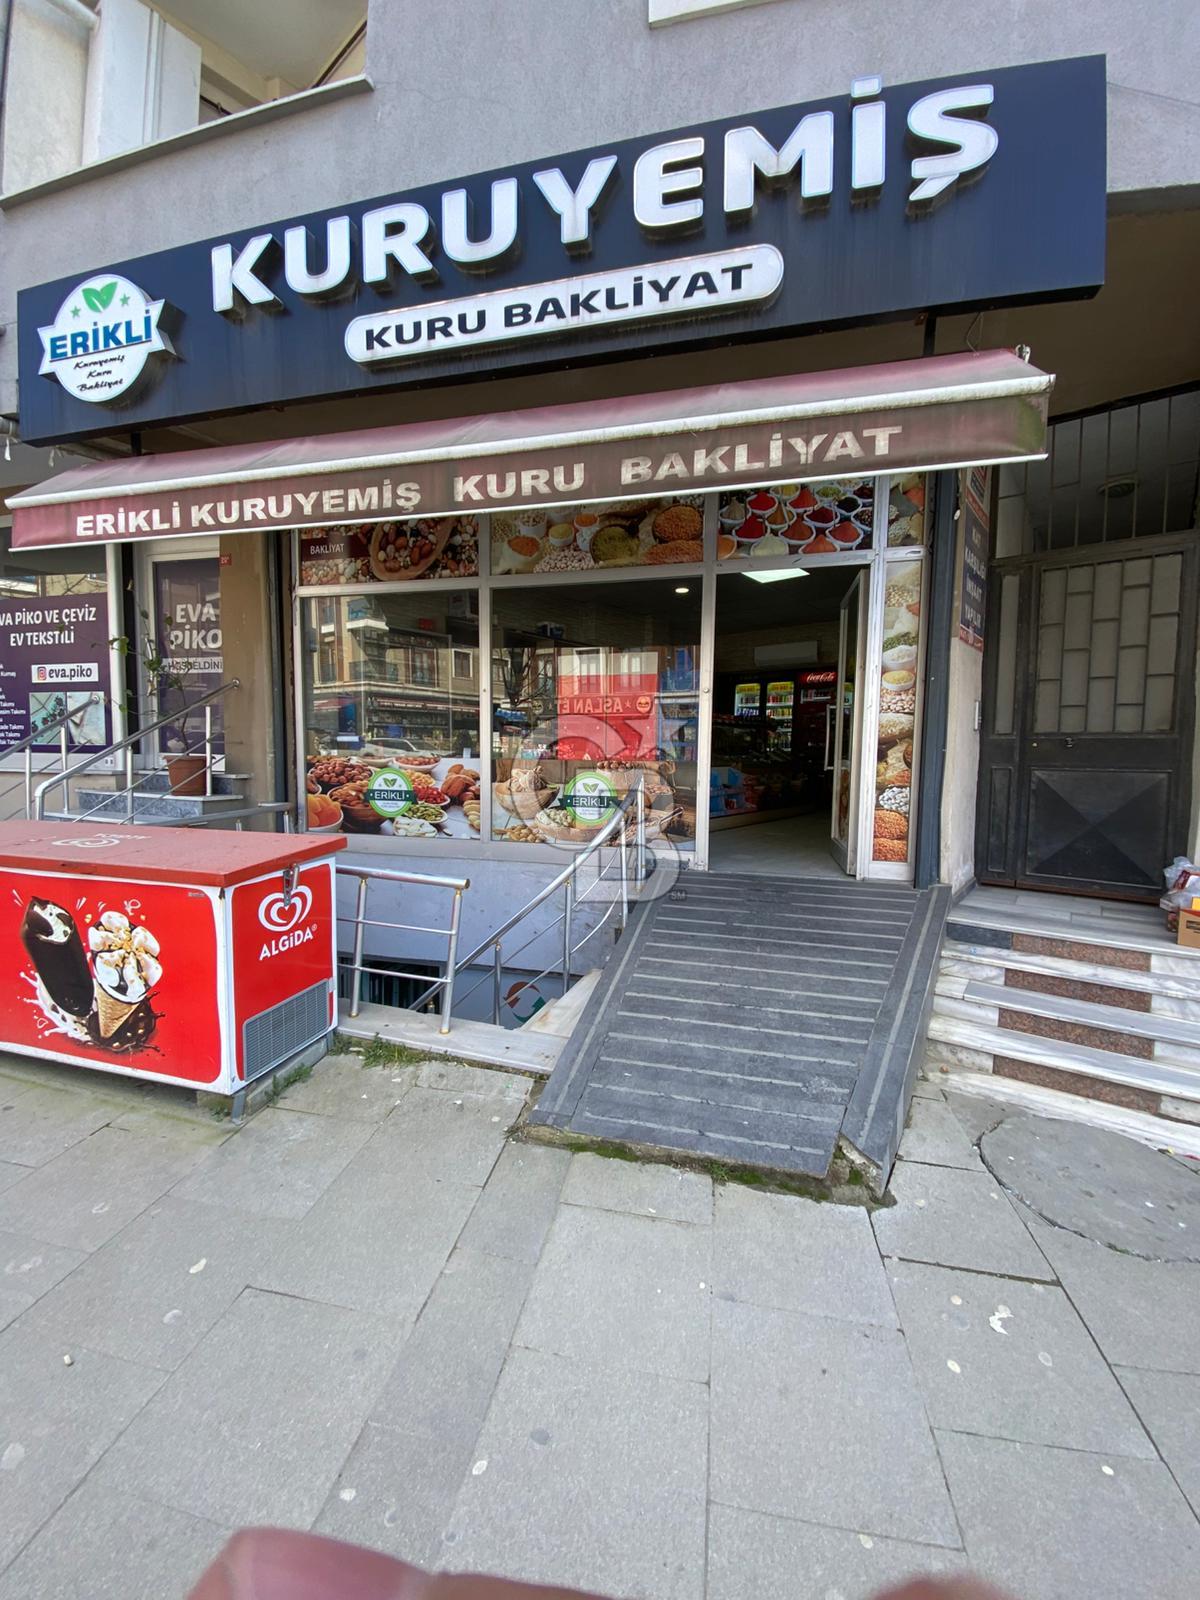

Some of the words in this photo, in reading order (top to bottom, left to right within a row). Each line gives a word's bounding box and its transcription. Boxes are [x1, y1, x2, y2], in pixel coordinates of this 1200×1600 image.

[211, 75, 998, 313] KURUYEMİŞ
[365, 309, 486, 350] KURU
[503, 263, 753, 327] BAKLİYAT
[50, 309, 152, 360] ERİKLİ
[76, 501, 181, 537] ERİKLİ
[191, 478, 422, 528] KURUYEMİŞ
[453, 462, 586, 502] KURU
[620, 425, 903, 486] BAKLİYAT
[0, 613, 13, 626] VA
[15, 608, 42, 625] PİKO
[45, 610, 59, 623] VE
[62, 604, 96, 625] ÇEYİZ
[176, 603, 216, 623] EVA
[10, 633, 24, 646] EV
[169, 625, 222, 650] PİKO
[48, 665, 92, 680] eva.piko
[374, 790, 405, 800] ERİKLİ
[572, 796, 607, 807] ERİKLİ
